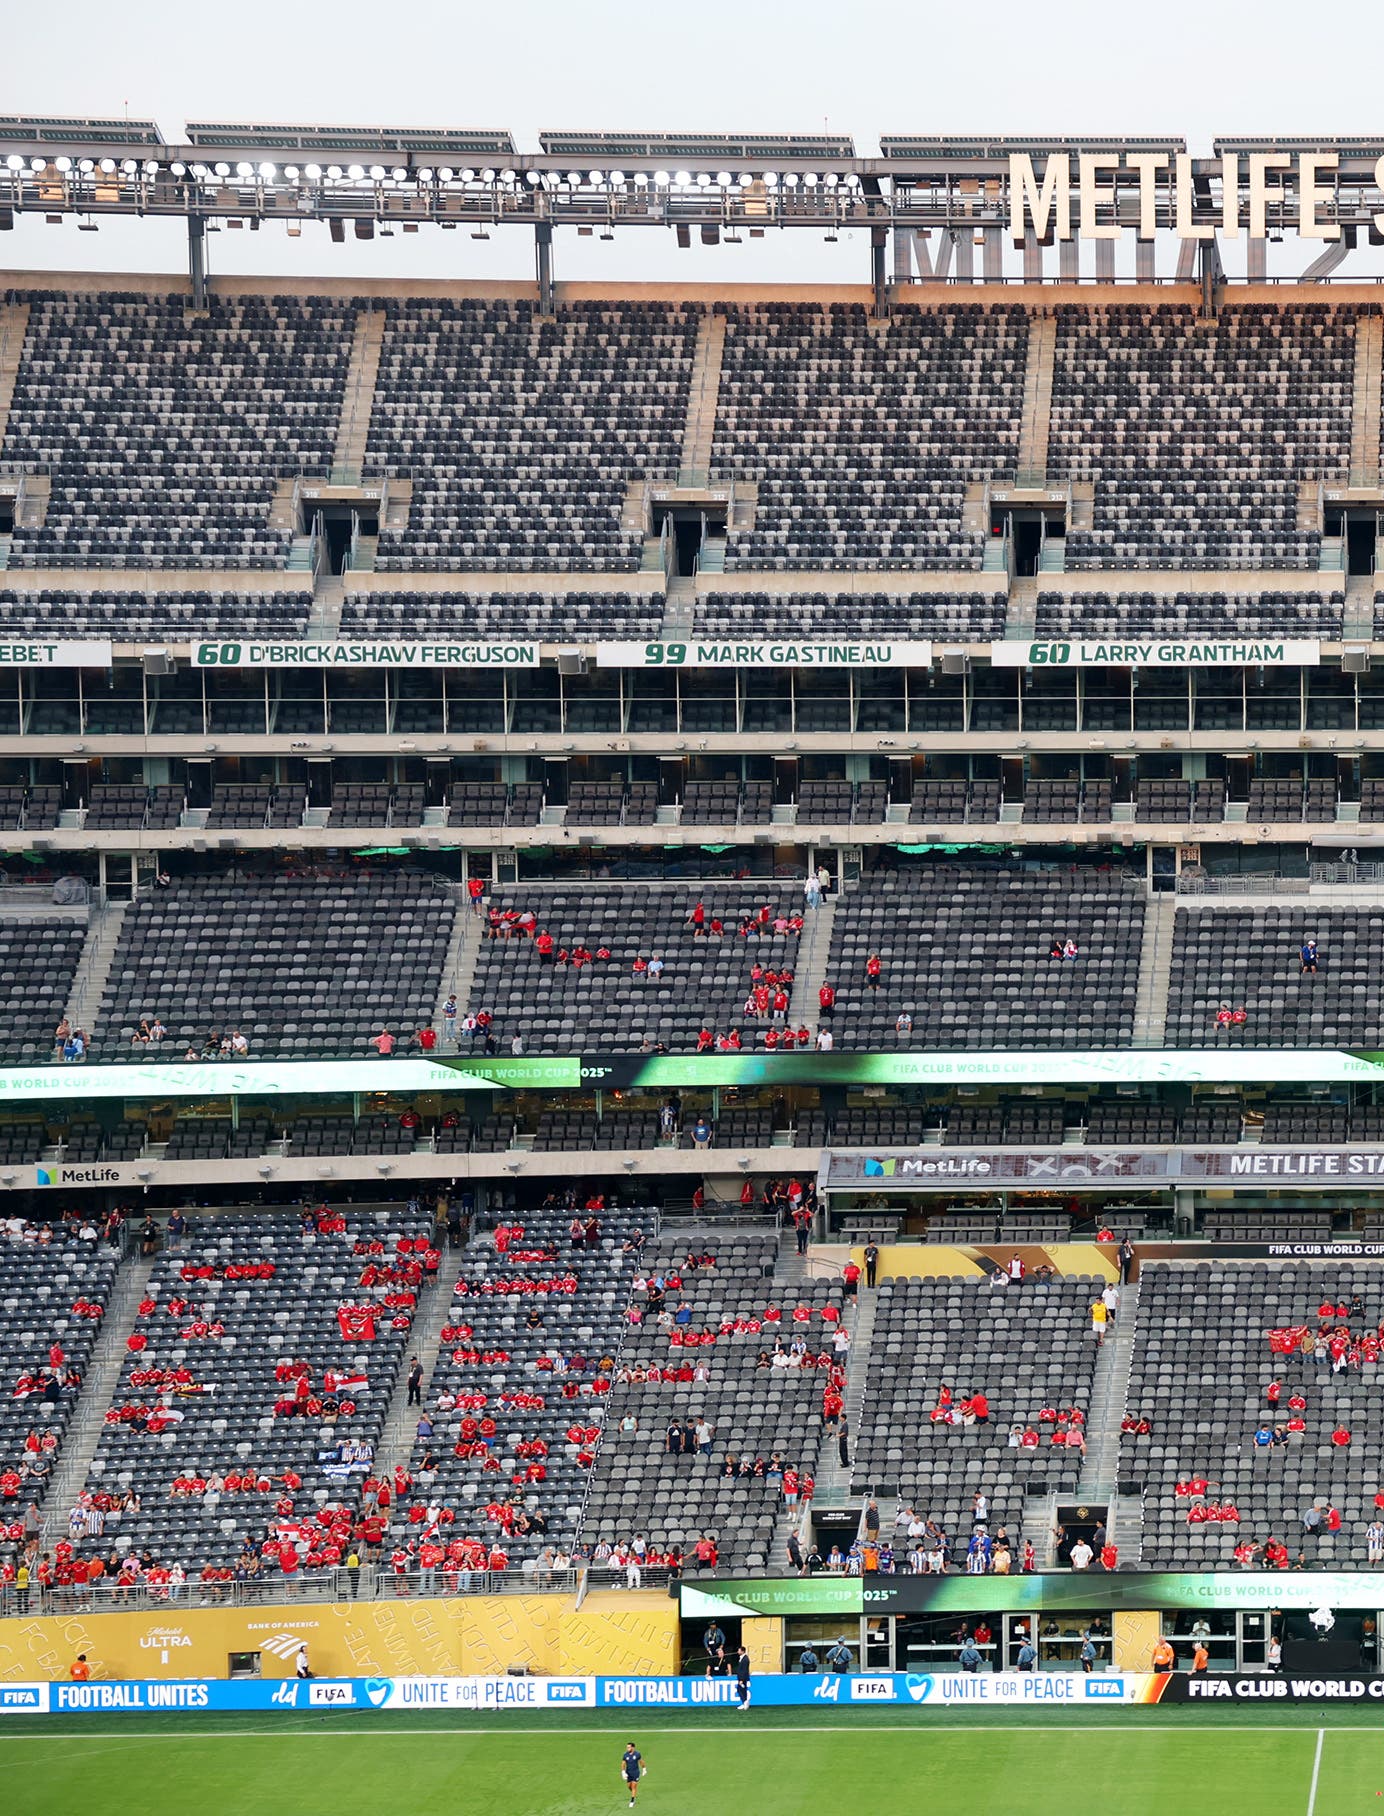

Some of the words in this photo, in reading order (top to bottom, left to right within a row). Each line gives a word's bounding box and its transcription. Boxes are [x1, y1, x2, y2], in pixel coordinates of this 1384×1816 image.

[1007, 152, 1342, 240] METLIFE
[0, 645, 57, 662] EBET
[198, 644, 241, 664] 60
[250, 646, 416, 662] D'BRICKASHAW
[422, 647, 533, 662] FERGUSON
[644, 642, 687, 666] 99
[698, 646, 763, 662] MARK
[770, 646, 891, 662] GASTINEAU
[1028, 642, 1071, 665] 60
[1082, 646, 1152, 661] LARRY
[1158, 645, 1283, 661] GRANTHAM
[956, 1064, 1001, 1073] WORLD
[1343, 1061, 1369, 1072] FIFA
[430, 1070, 458, 1080] FIFA
[460, 1068, 493, 1079] CLUB
[495, 1068, 542, 1079] WORLD
[544, 1068, 571, 1078] CUP
[901, 1159, 991, 1174] MetLife
[1230, 1155, 1340, 1174] METLIFE
[63, 1169, 119, 1182] MetLife
[1269, 1245, 1292, 1255] FIFA
[1294, 1245, 1321, 1254] CLUB
[1323, 1245, 1362, 1255] WORLD
[736, 1592, 770, 1603] CLUB
[826, 1591, 852, 1602] CUP
[1198, 1586, 1232, 1597] CLUB
[1235, 1586, 1284, 1597] WORLD
[247, 1622, 271, 1630] BANK
[284, 1620, 320, 1628] AMERICA
[140, 1636, 192, 1649] ULTRA
[316, 1689, 347, 1701] FIFA
[403, 1683, 448, 1702] UNITE
[457, 1686, 477, 1700] FOR
[486, 1682, 535, 1702] PEACE
[550, 1686, 583, 1698] FIFA
[603, 1680, 689, 1703] FOOTBALL
[857, 1683, 888, 1695] FIFA
[943, 1679, 987, 1698] UNITE
[996, 1682, 1016, 1695] FOR
[1025, 1678, 1073, 1698] PEACE
[1088, 1683, 1121, 1695] FIFA
[1189, 1680, 1232, 1696] FIFA
[1236, 1680, 1287, 1696] CLUB
[1291, 1681, 1368, 1696] WORLD
[3, 1690, 36, 1705] FIFA
[59, 1686, 144, 1707] FOOTBALL
[148, 1685, 208, 1706] UNITES
